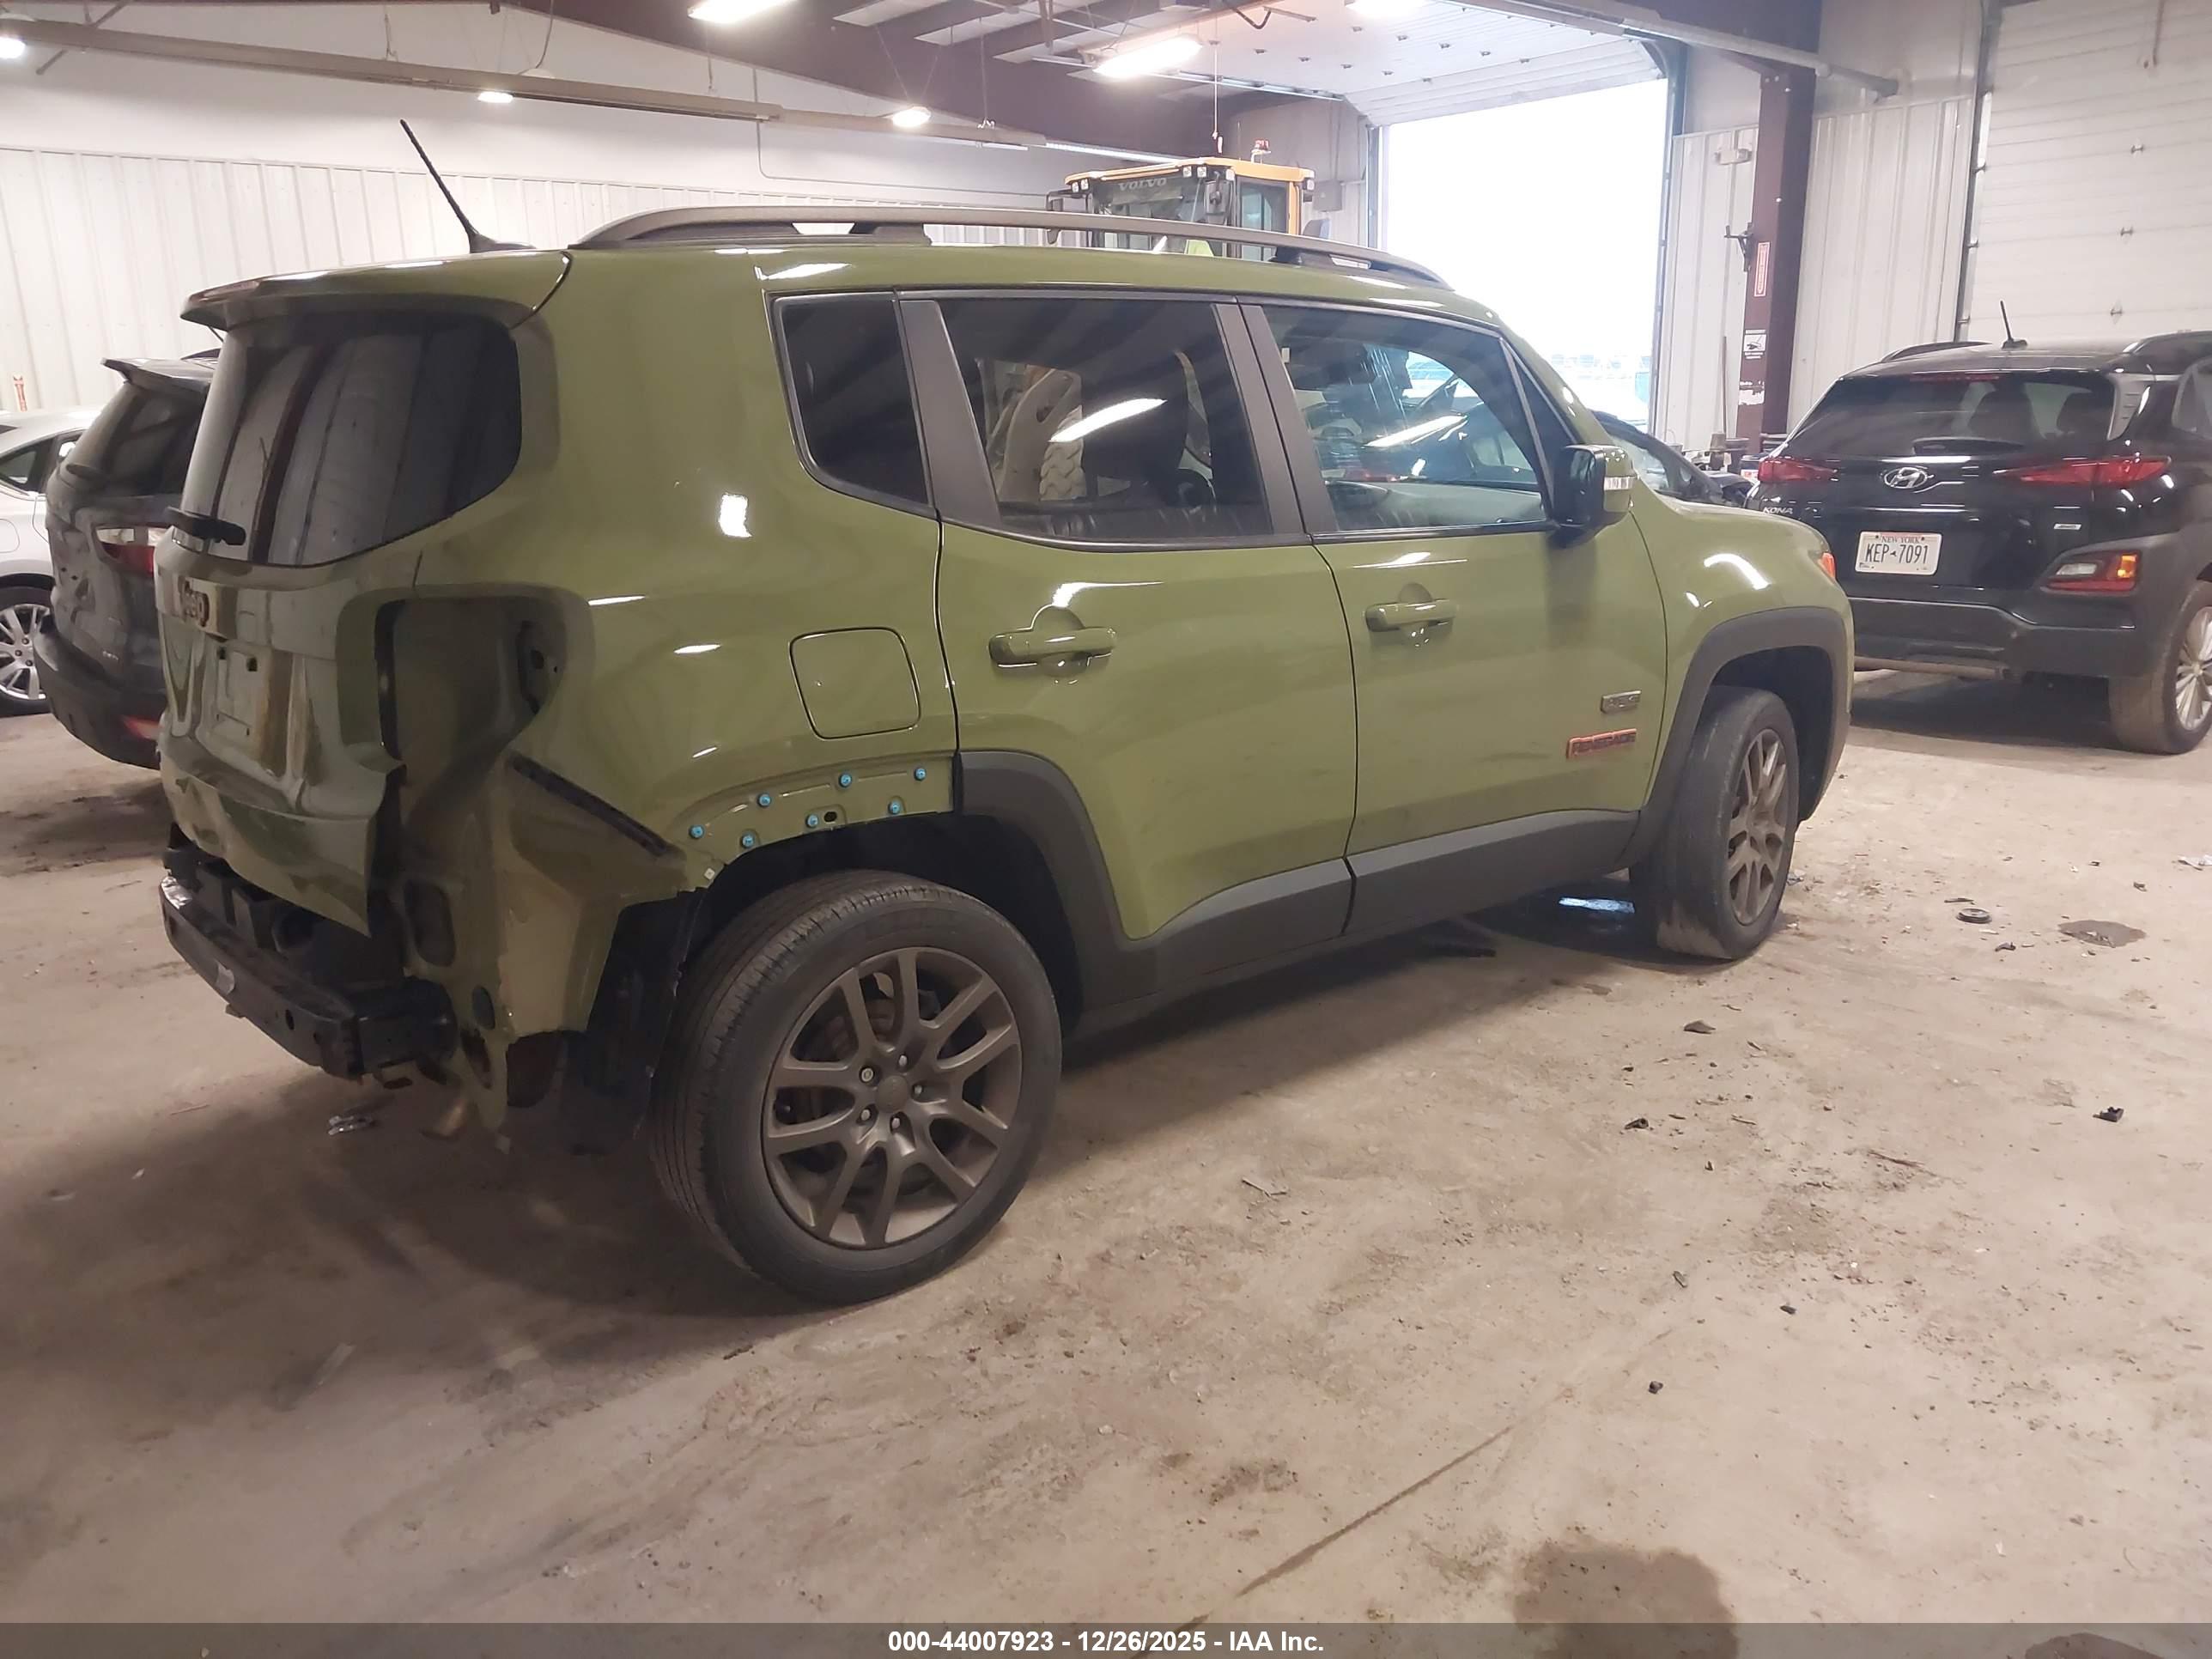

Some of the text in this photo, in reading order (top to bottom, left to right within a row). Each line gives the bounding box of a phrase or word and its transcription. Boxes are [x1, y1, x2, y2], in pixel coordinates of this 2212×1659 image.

[1119, 178, 1167, 191] VOLVO
[1865, 544, 1928, 563] KEP 7091
